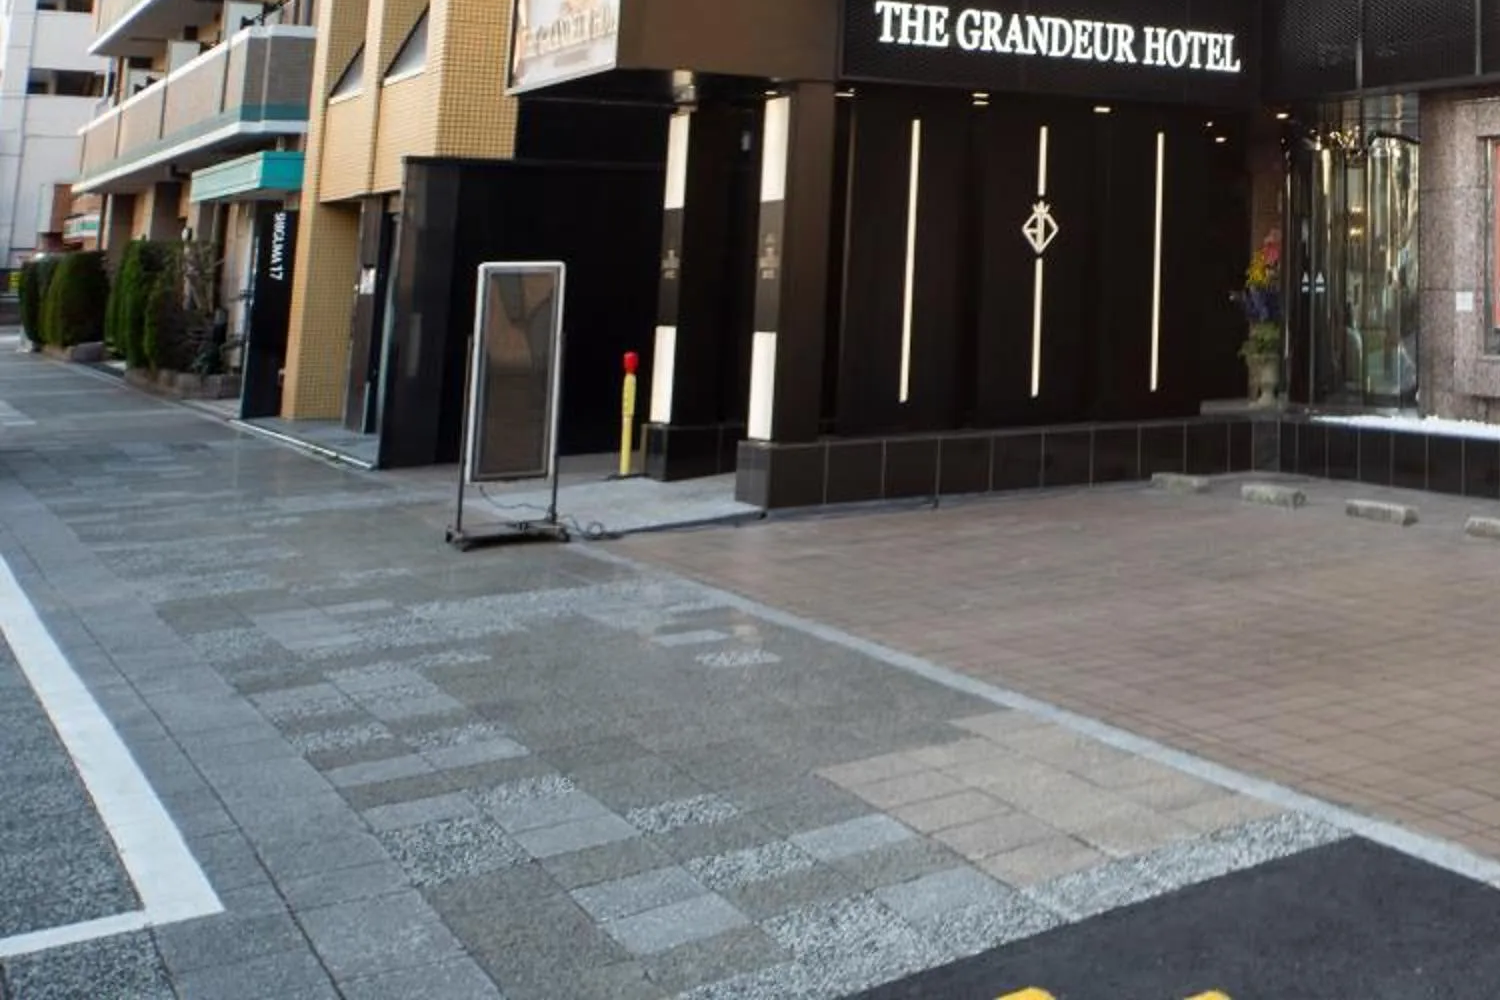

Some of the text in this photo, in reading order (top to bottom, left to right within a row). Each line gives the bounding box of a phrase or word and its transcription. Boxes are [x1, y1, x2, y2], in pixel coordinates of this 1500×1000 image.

[874, 0, 1241, 73] THE GRANDEUR HOTEL
